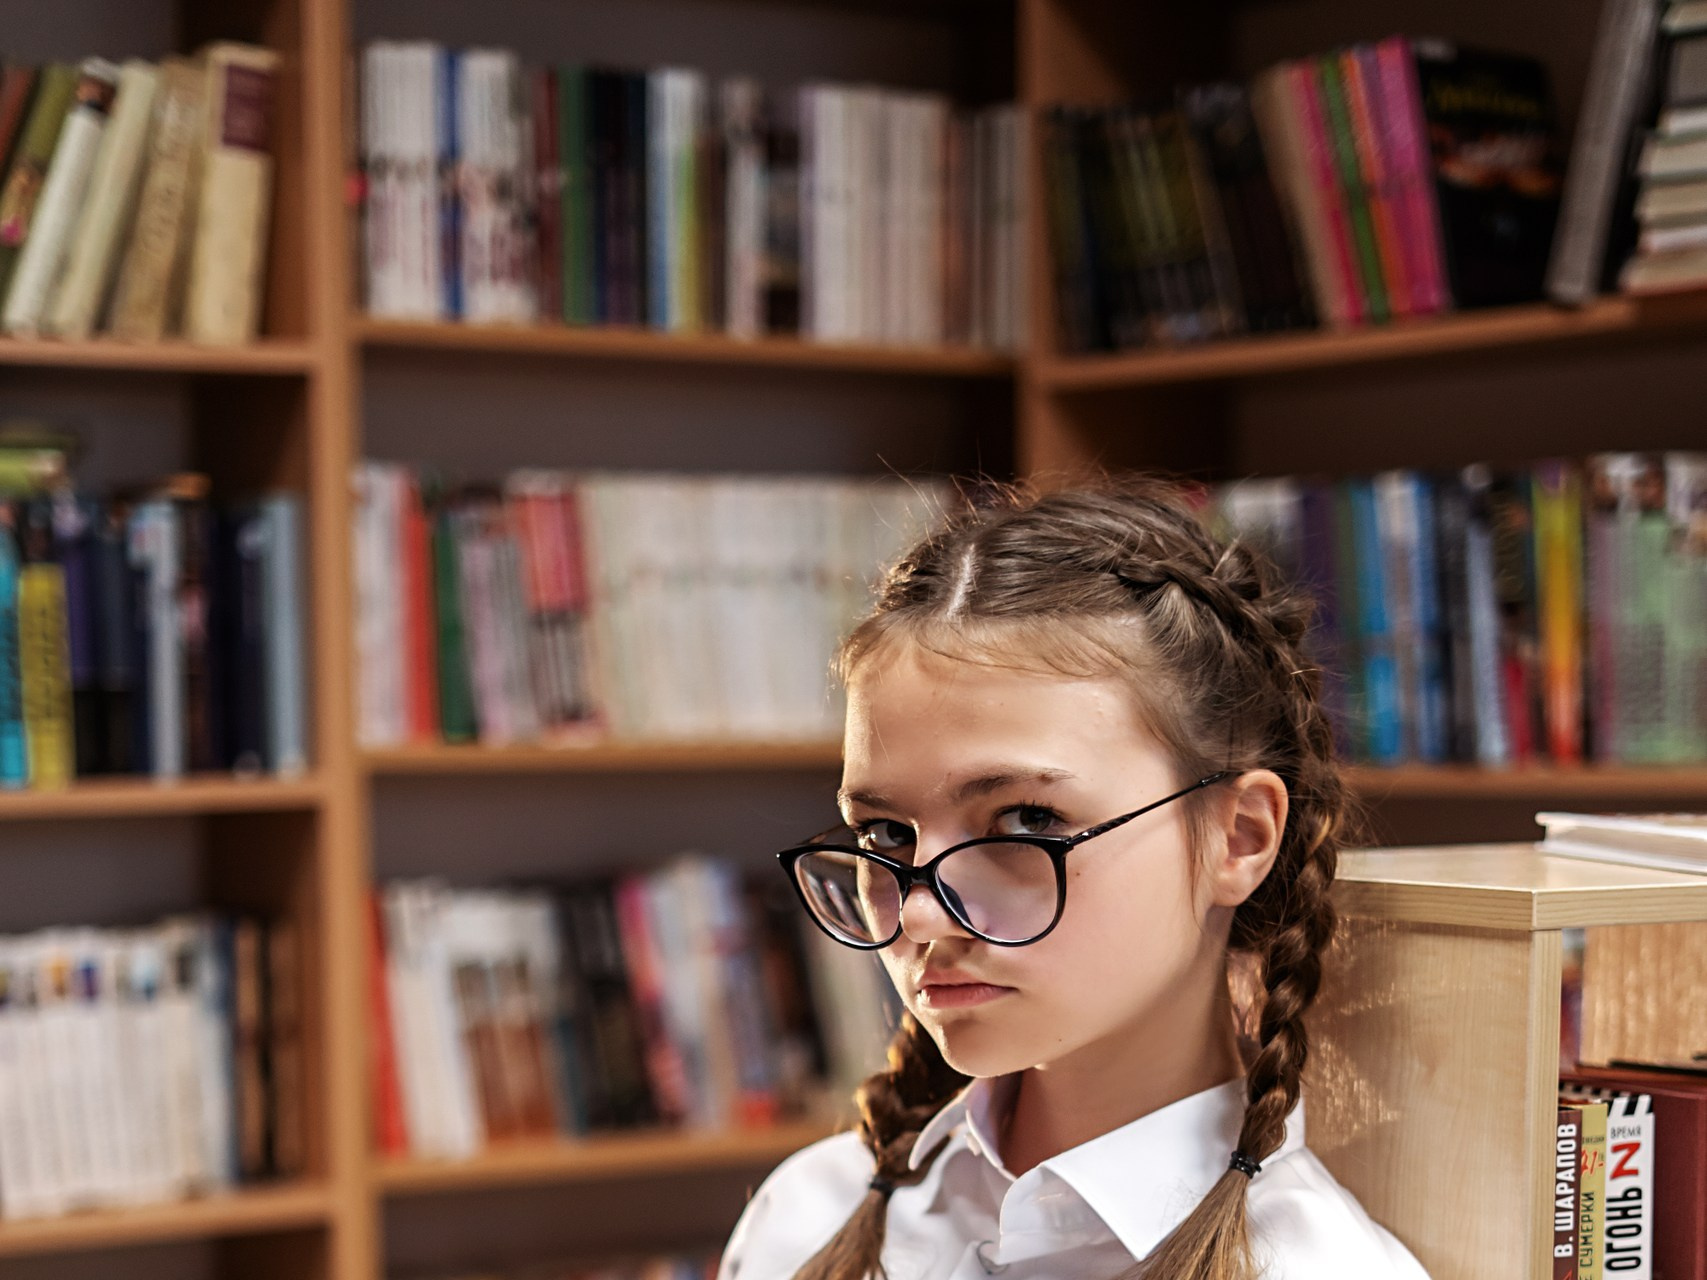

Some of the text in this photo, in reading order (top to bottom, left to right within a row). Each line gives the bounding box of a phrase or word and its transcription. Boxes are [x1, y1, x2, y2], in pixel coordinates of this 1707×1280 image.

[1610, 1126, 1642, 1139] ВРЕМЯ
[1610, 1141, 1642, 1181] Z
[1555, 1124, 1577, 1231] ШАРАПОВ
[1580, 1191, 1595, 1267] СУМЕРКИ
[1604, 1187, 1642, 1271] ОГОНЬ
